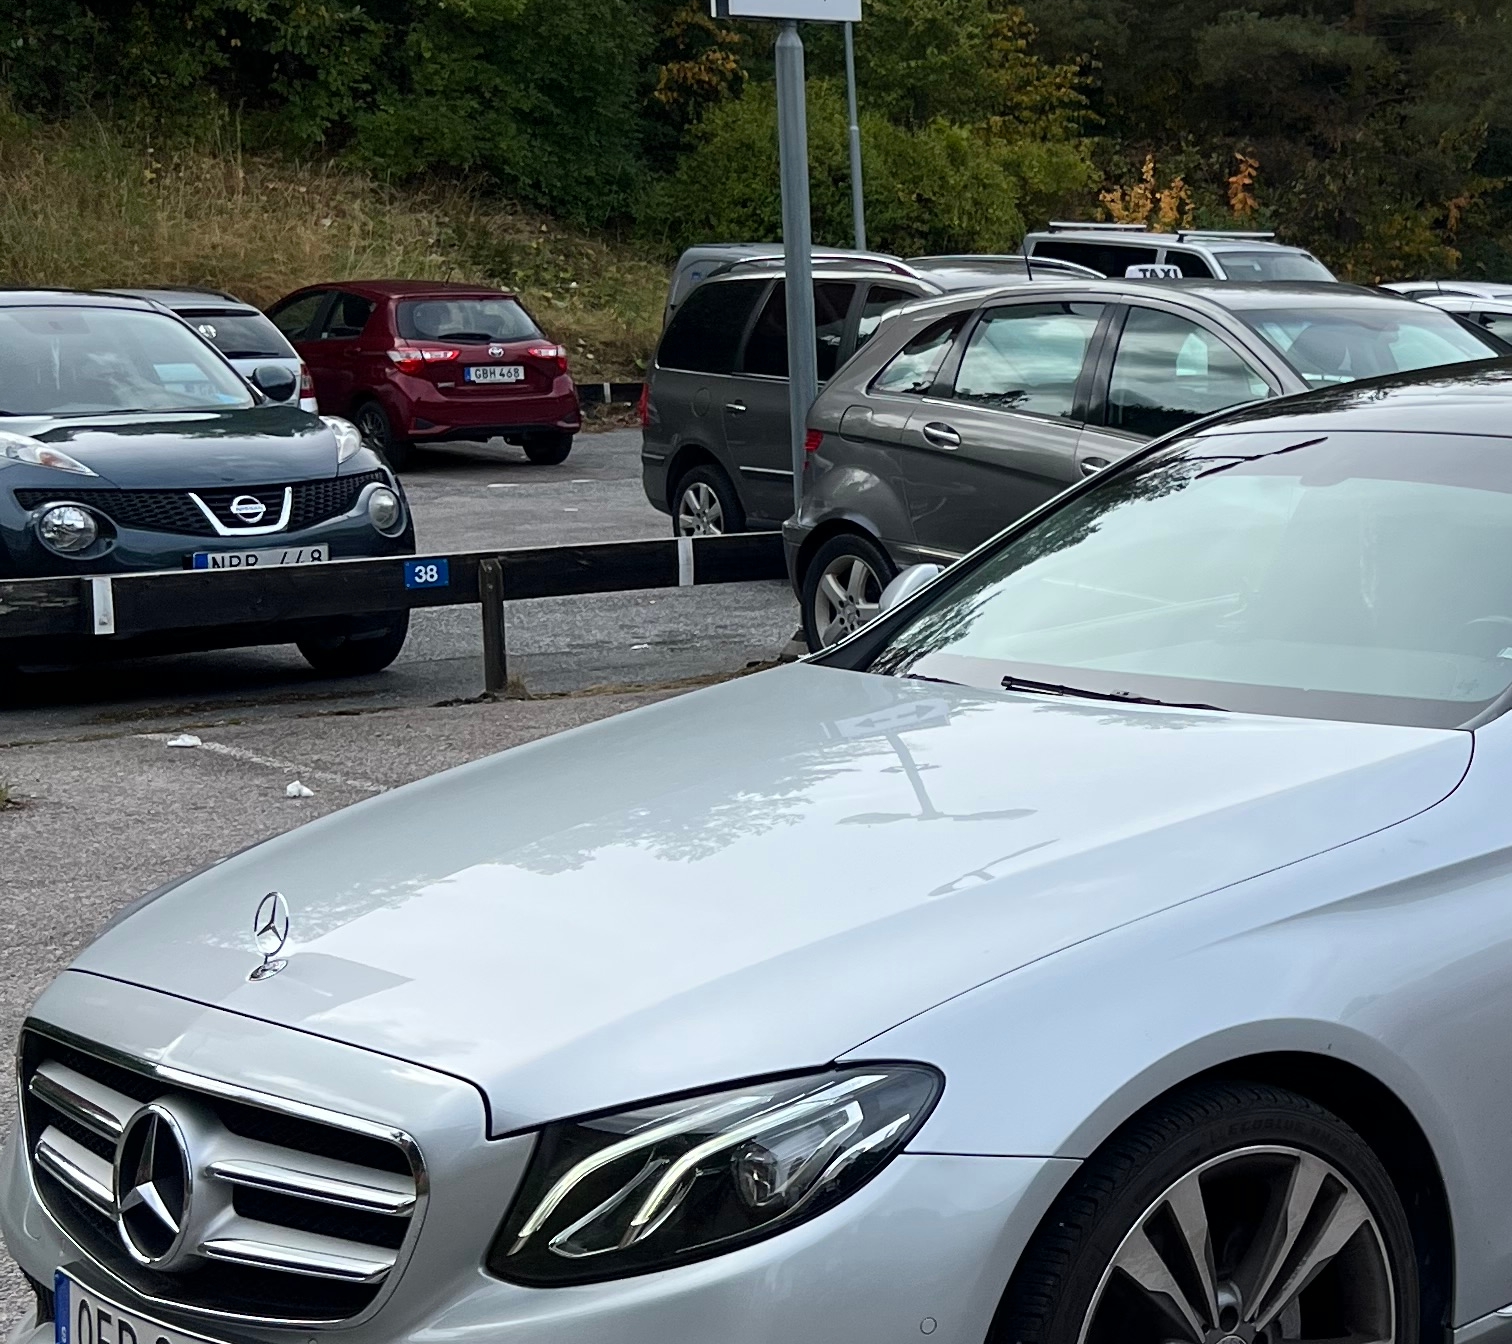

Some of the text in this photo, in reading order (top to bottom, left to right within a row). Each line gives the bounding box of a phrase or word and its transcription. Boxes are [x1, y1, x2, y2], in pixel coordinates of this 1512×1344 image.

[1138, 268, 1179, 279] TAXI
[474, 367, 520, 379] GBH 468
[414, 564, 438, 583] 38
